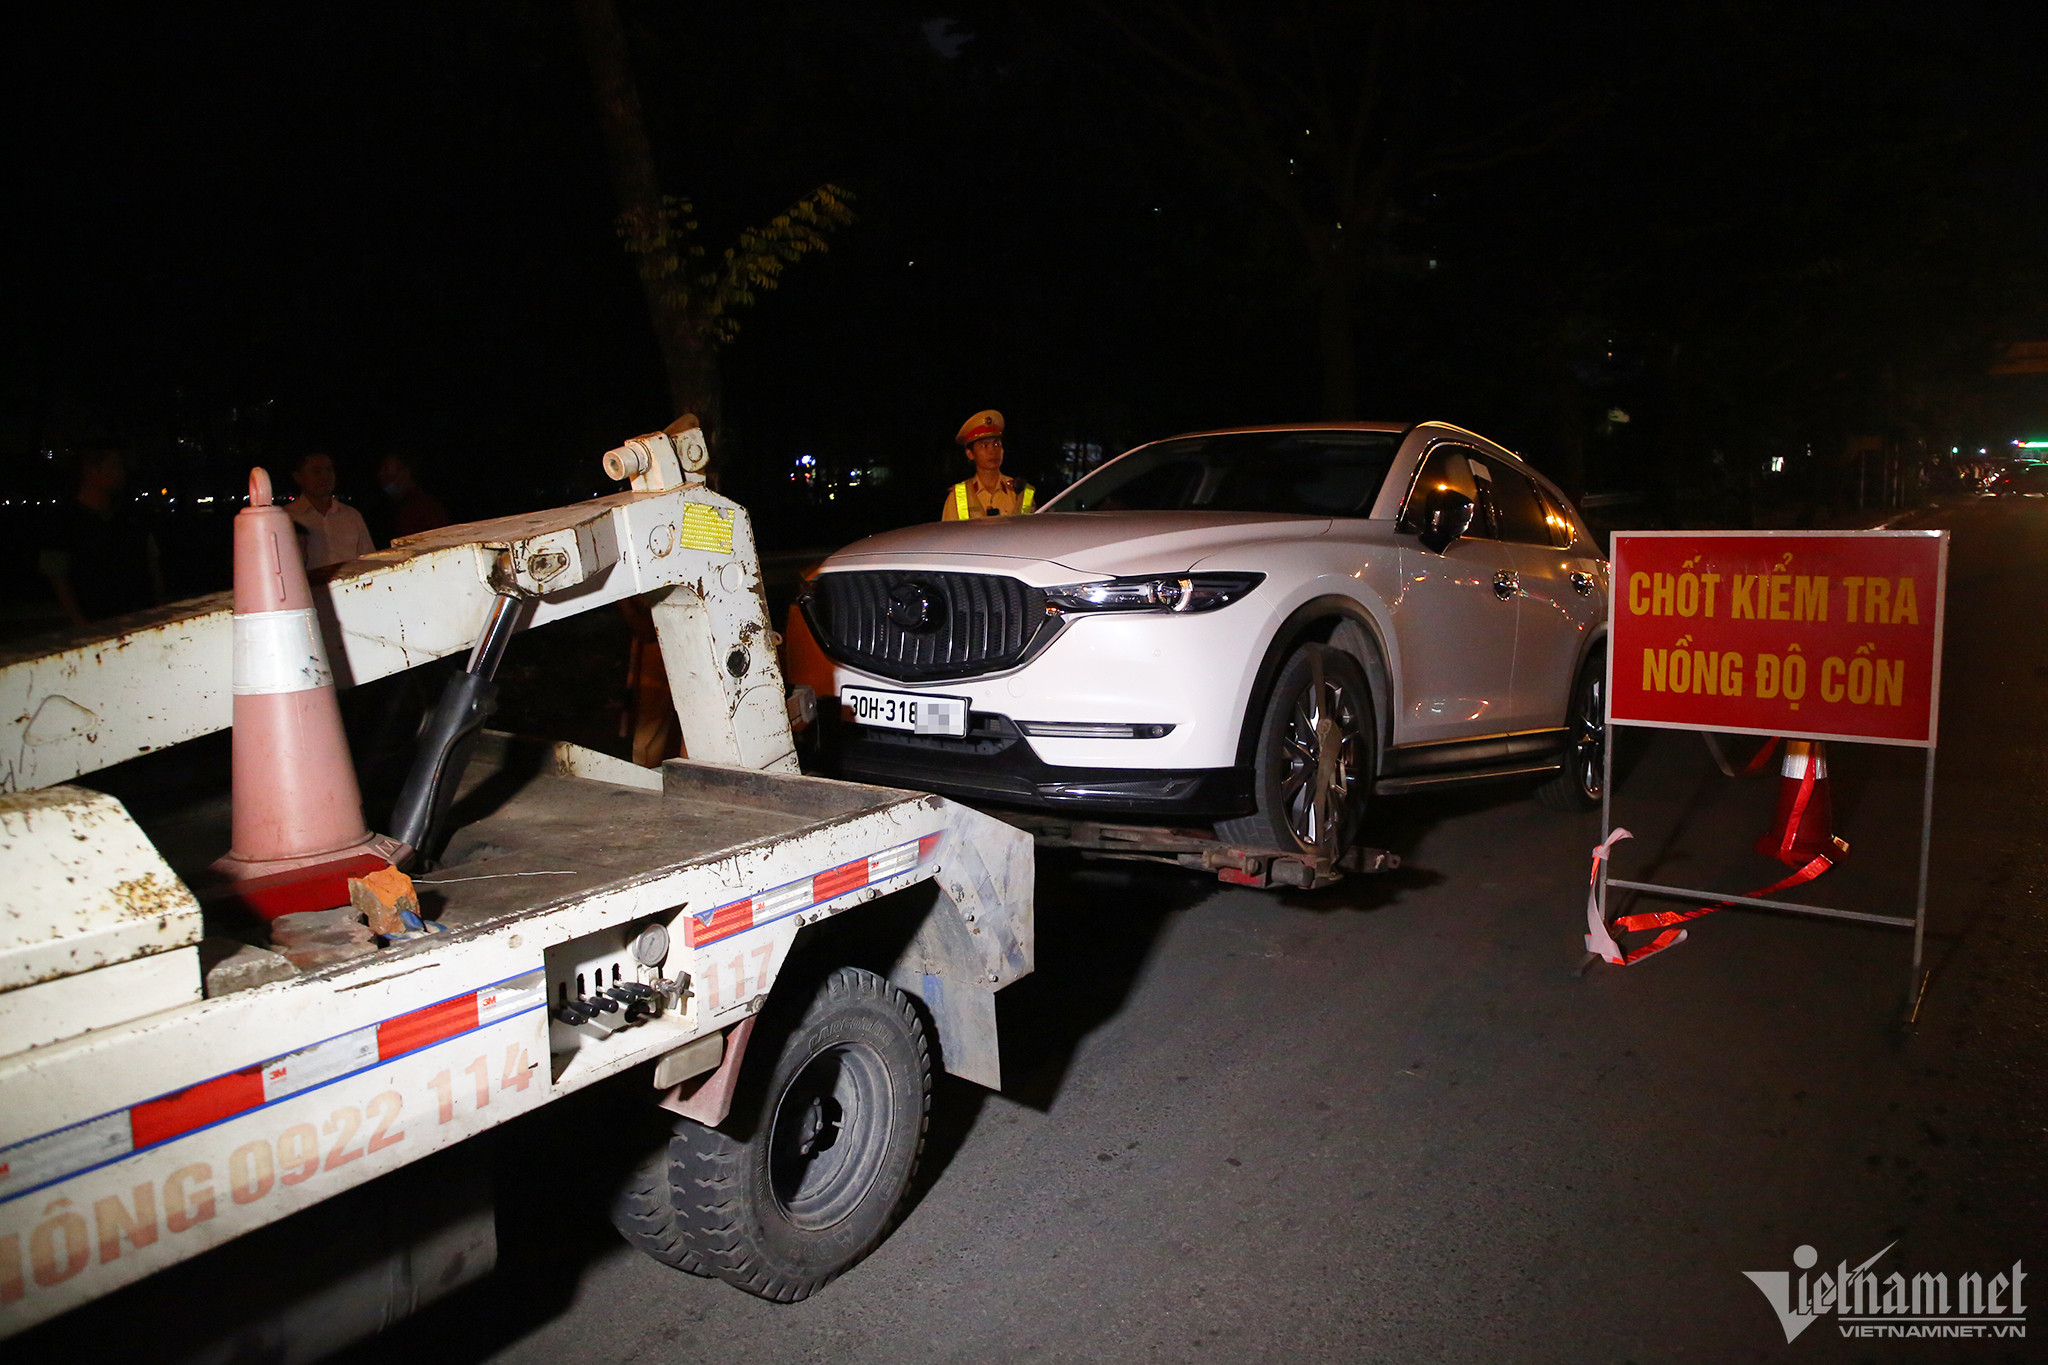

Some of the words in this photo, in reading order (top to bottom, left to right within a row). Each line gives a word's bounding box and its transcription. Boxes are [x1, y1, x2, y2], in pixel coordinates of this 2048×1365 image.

[1628, 555, 1720, 618] CHỐT
[1731, 552, 1829, 622] KIỂM
[1843, 576, 1919, 625] TRA
[1642, 634, 1744, 697] NỒNG
[1755, 643, 1806, 710] ĐỘ
[1820, 642, 1904, 707] CỒN
[482, 995, 497, 1006] 3M
[229, 1090, 405, 1204] 0922
[427, 1042, 534, 1125] 114
[701, 941, 774, 1010] 117
[269, 1067, 287, 1080] 3M
